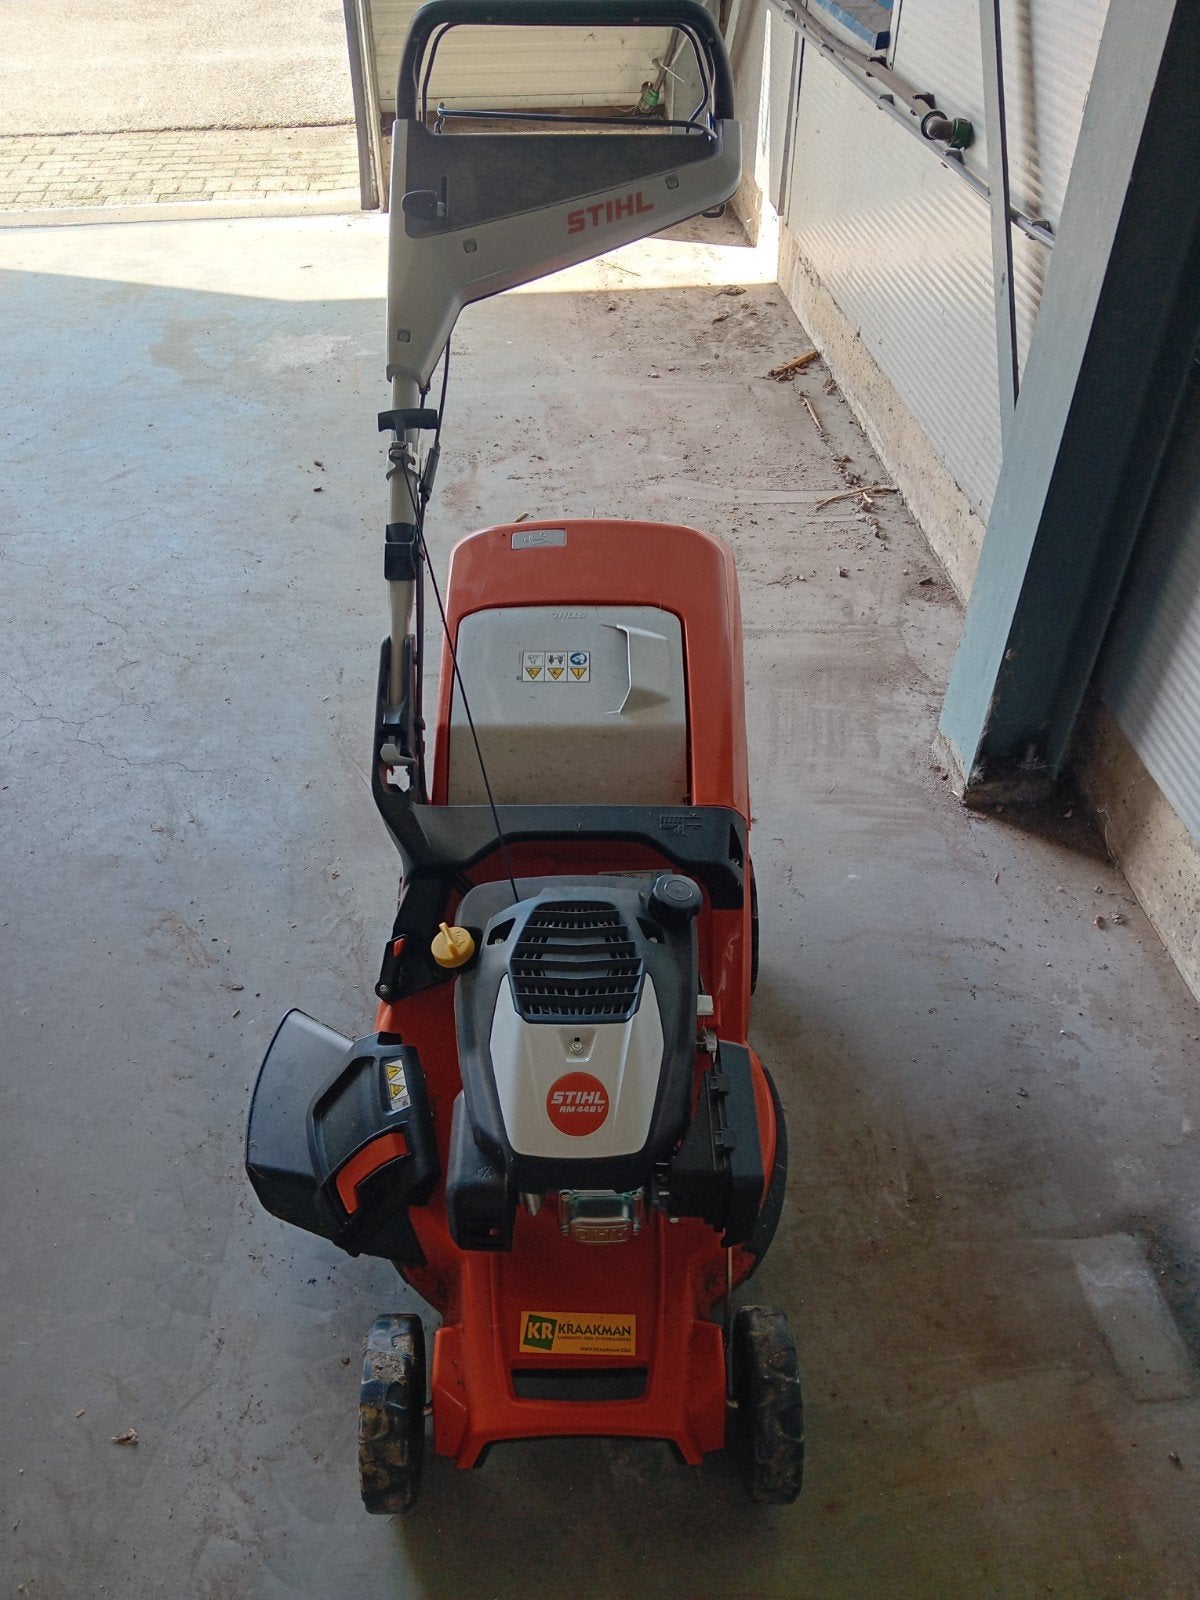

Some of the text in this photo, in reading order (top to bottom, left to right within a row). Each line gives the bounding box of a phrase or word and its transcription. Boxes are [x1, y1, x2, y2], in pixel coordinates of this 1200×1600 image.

[567, 191, 654, 234] STIHL
[550, 1091, 606, 1105] STIHL
[527, 1322, 554, 1339] KR
[558, 1323, 631, 1336] KRAAKMAN
